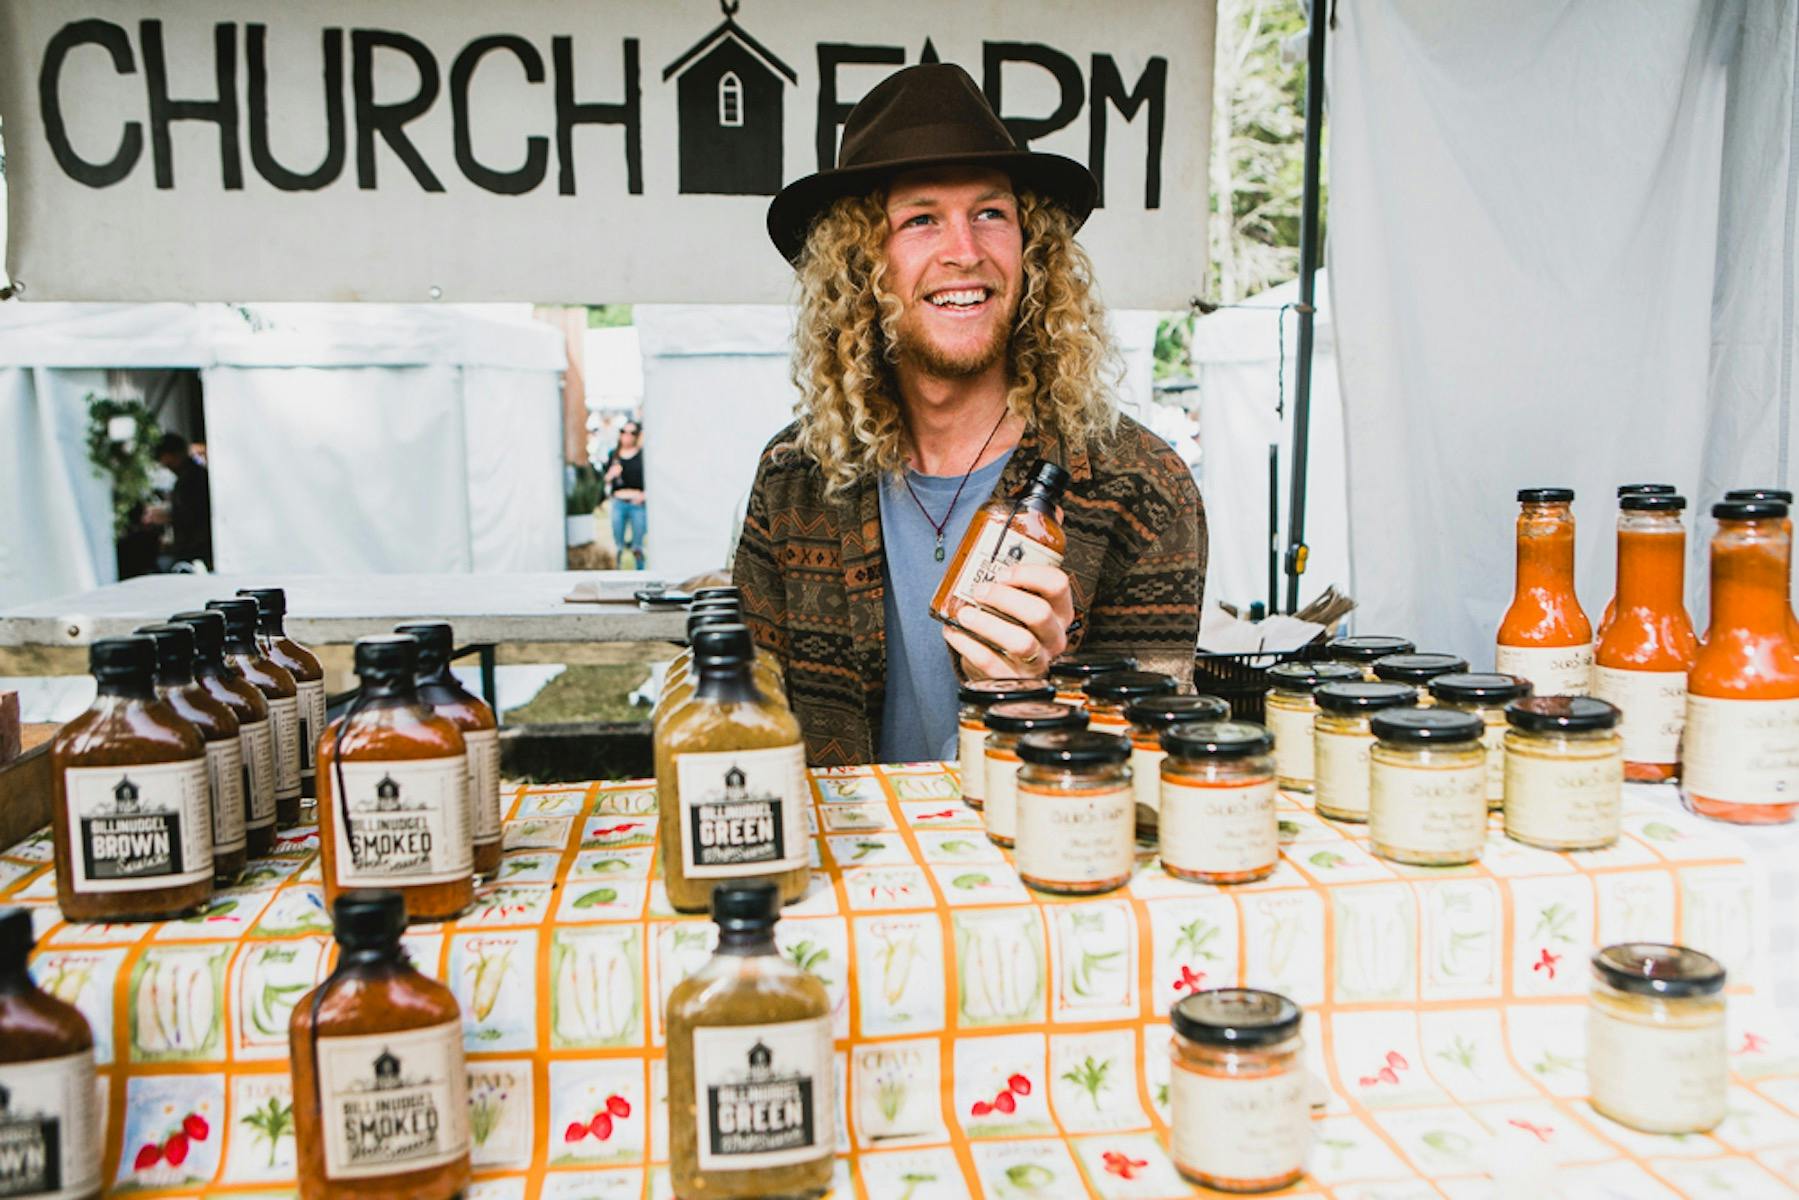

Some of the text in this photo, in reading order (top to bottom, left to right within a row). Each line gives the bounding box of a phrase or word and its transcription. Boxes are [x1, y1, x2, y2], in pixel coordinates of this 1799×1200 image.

[39, 17, 1168, 210] CHURCH FRM
[92, 832, 171, 860] BROWN
[350, 832, 432, 855] SMOKED
[699, 816, 775, 847] GREEN
[345, 1107, 438, 1140] SMOKED
[718, 1099, 804, 1134] GREEN
